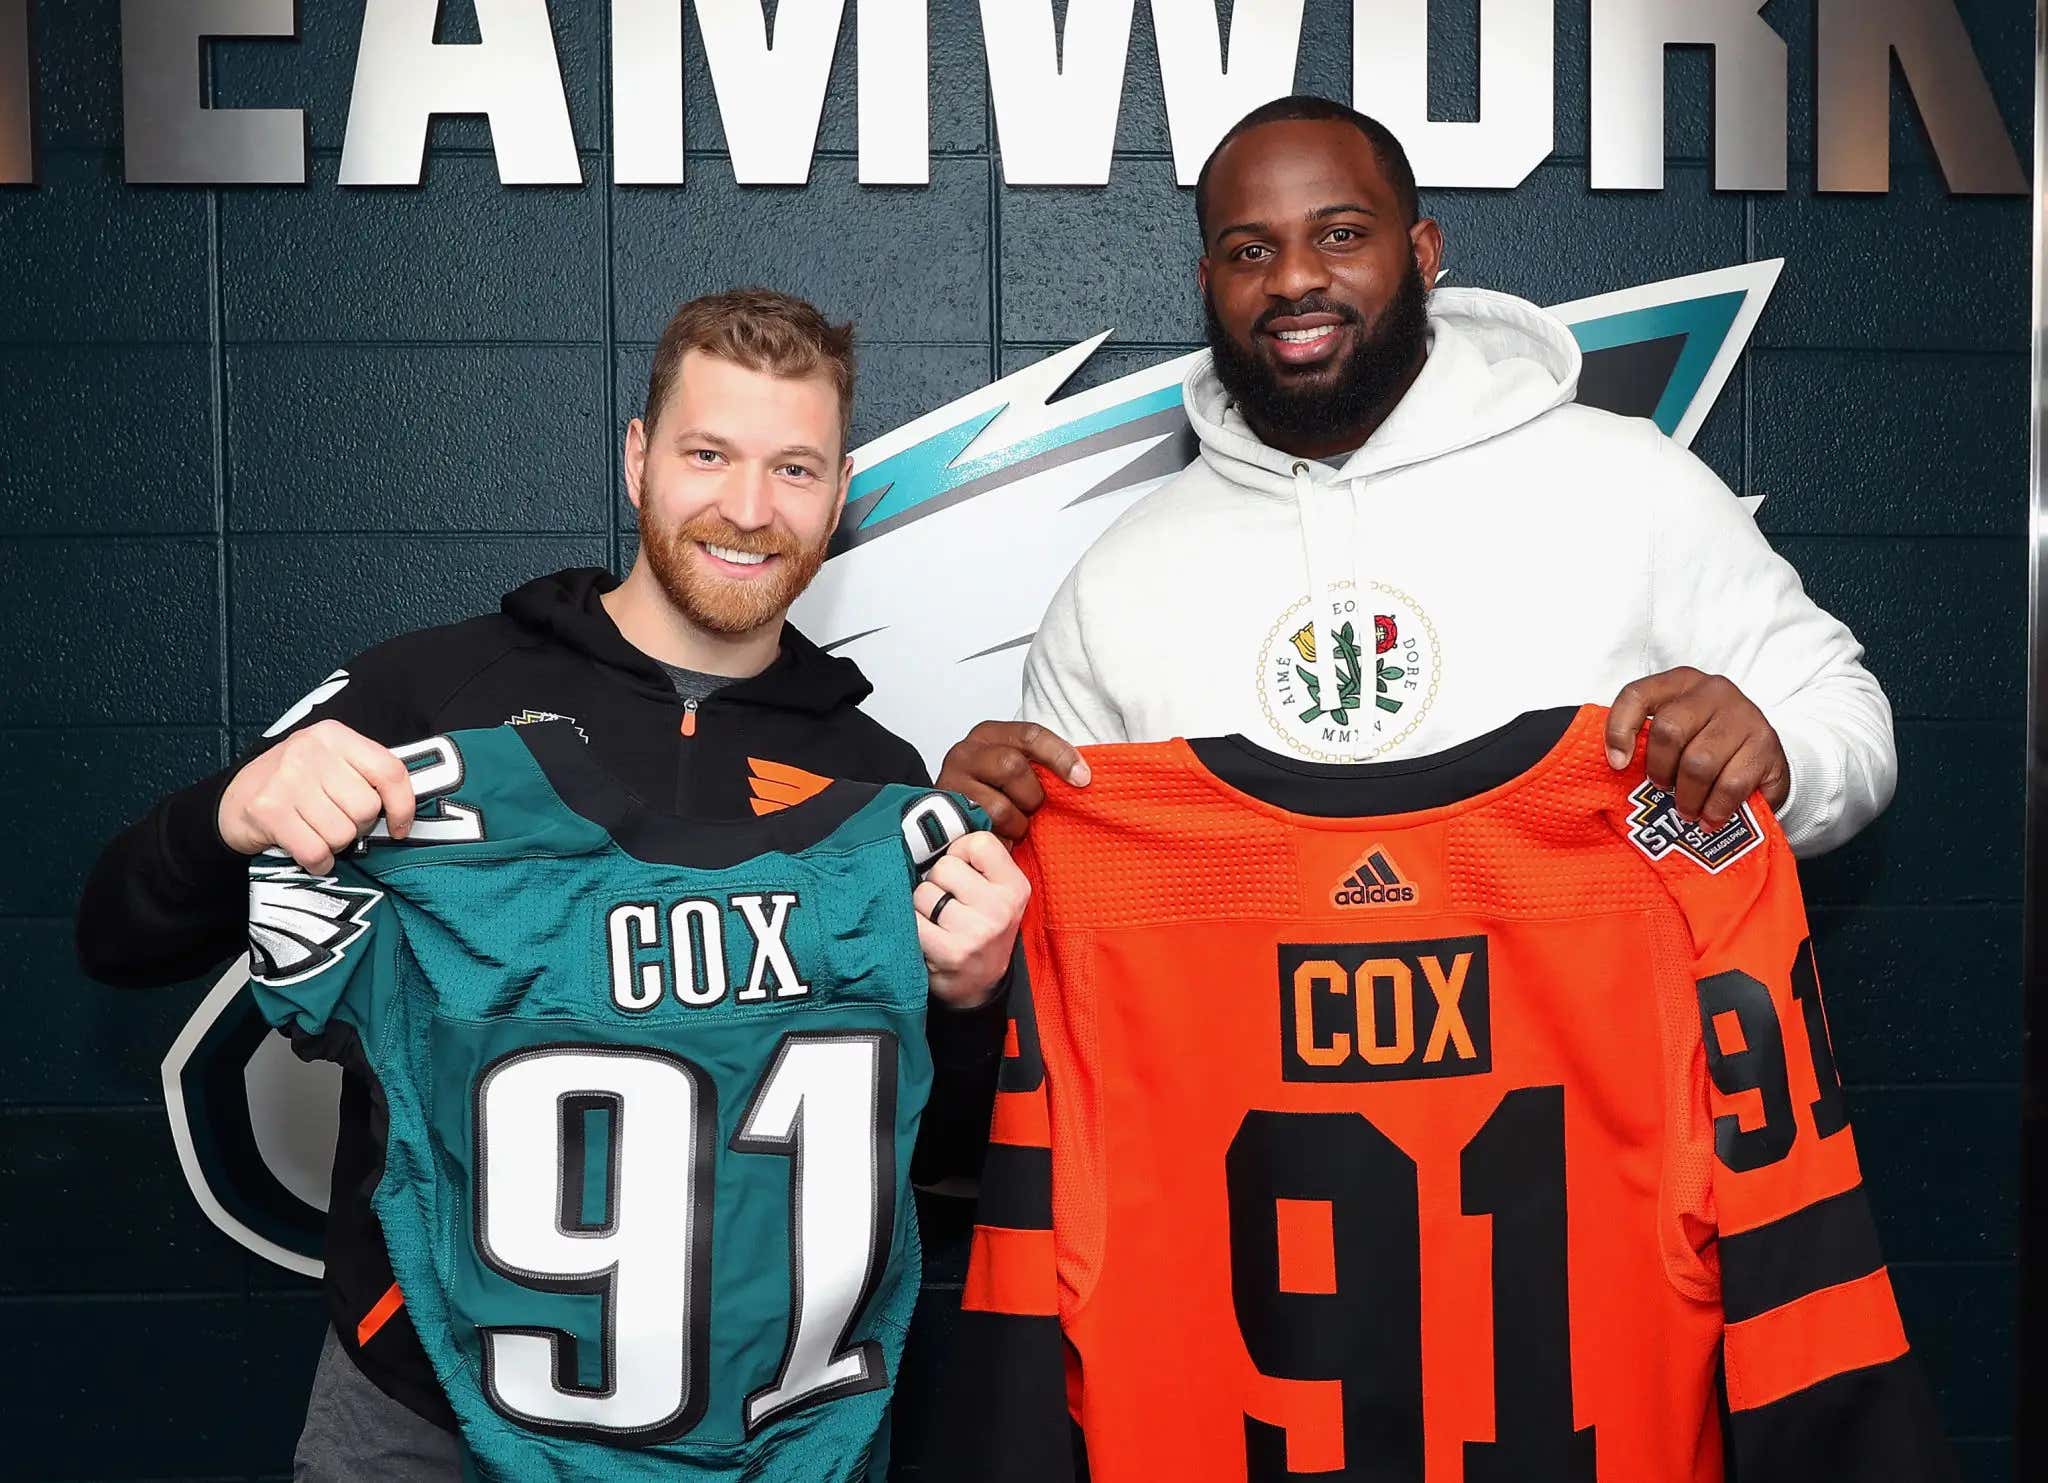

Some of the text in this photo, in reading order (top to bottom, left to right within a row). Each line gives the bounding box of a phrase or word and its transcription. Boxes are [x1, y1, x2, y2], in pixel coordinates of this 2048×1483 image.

[0, 0, 2029, 195] EAMWORK
[1403, 638, 1420, 691] DORE
[1335, 885, 1414, 905] adidas
[1704, 827, 1748, 859] PHILADELPHIA
[605, 890, 813, 1014] COX
[1294, 952, 1478, 1066] COX
[1695, 935, 1852, 1174] 91
[472, 1030, 899, 1448] 91
[1225, 1084, 1598, 1483] 91
